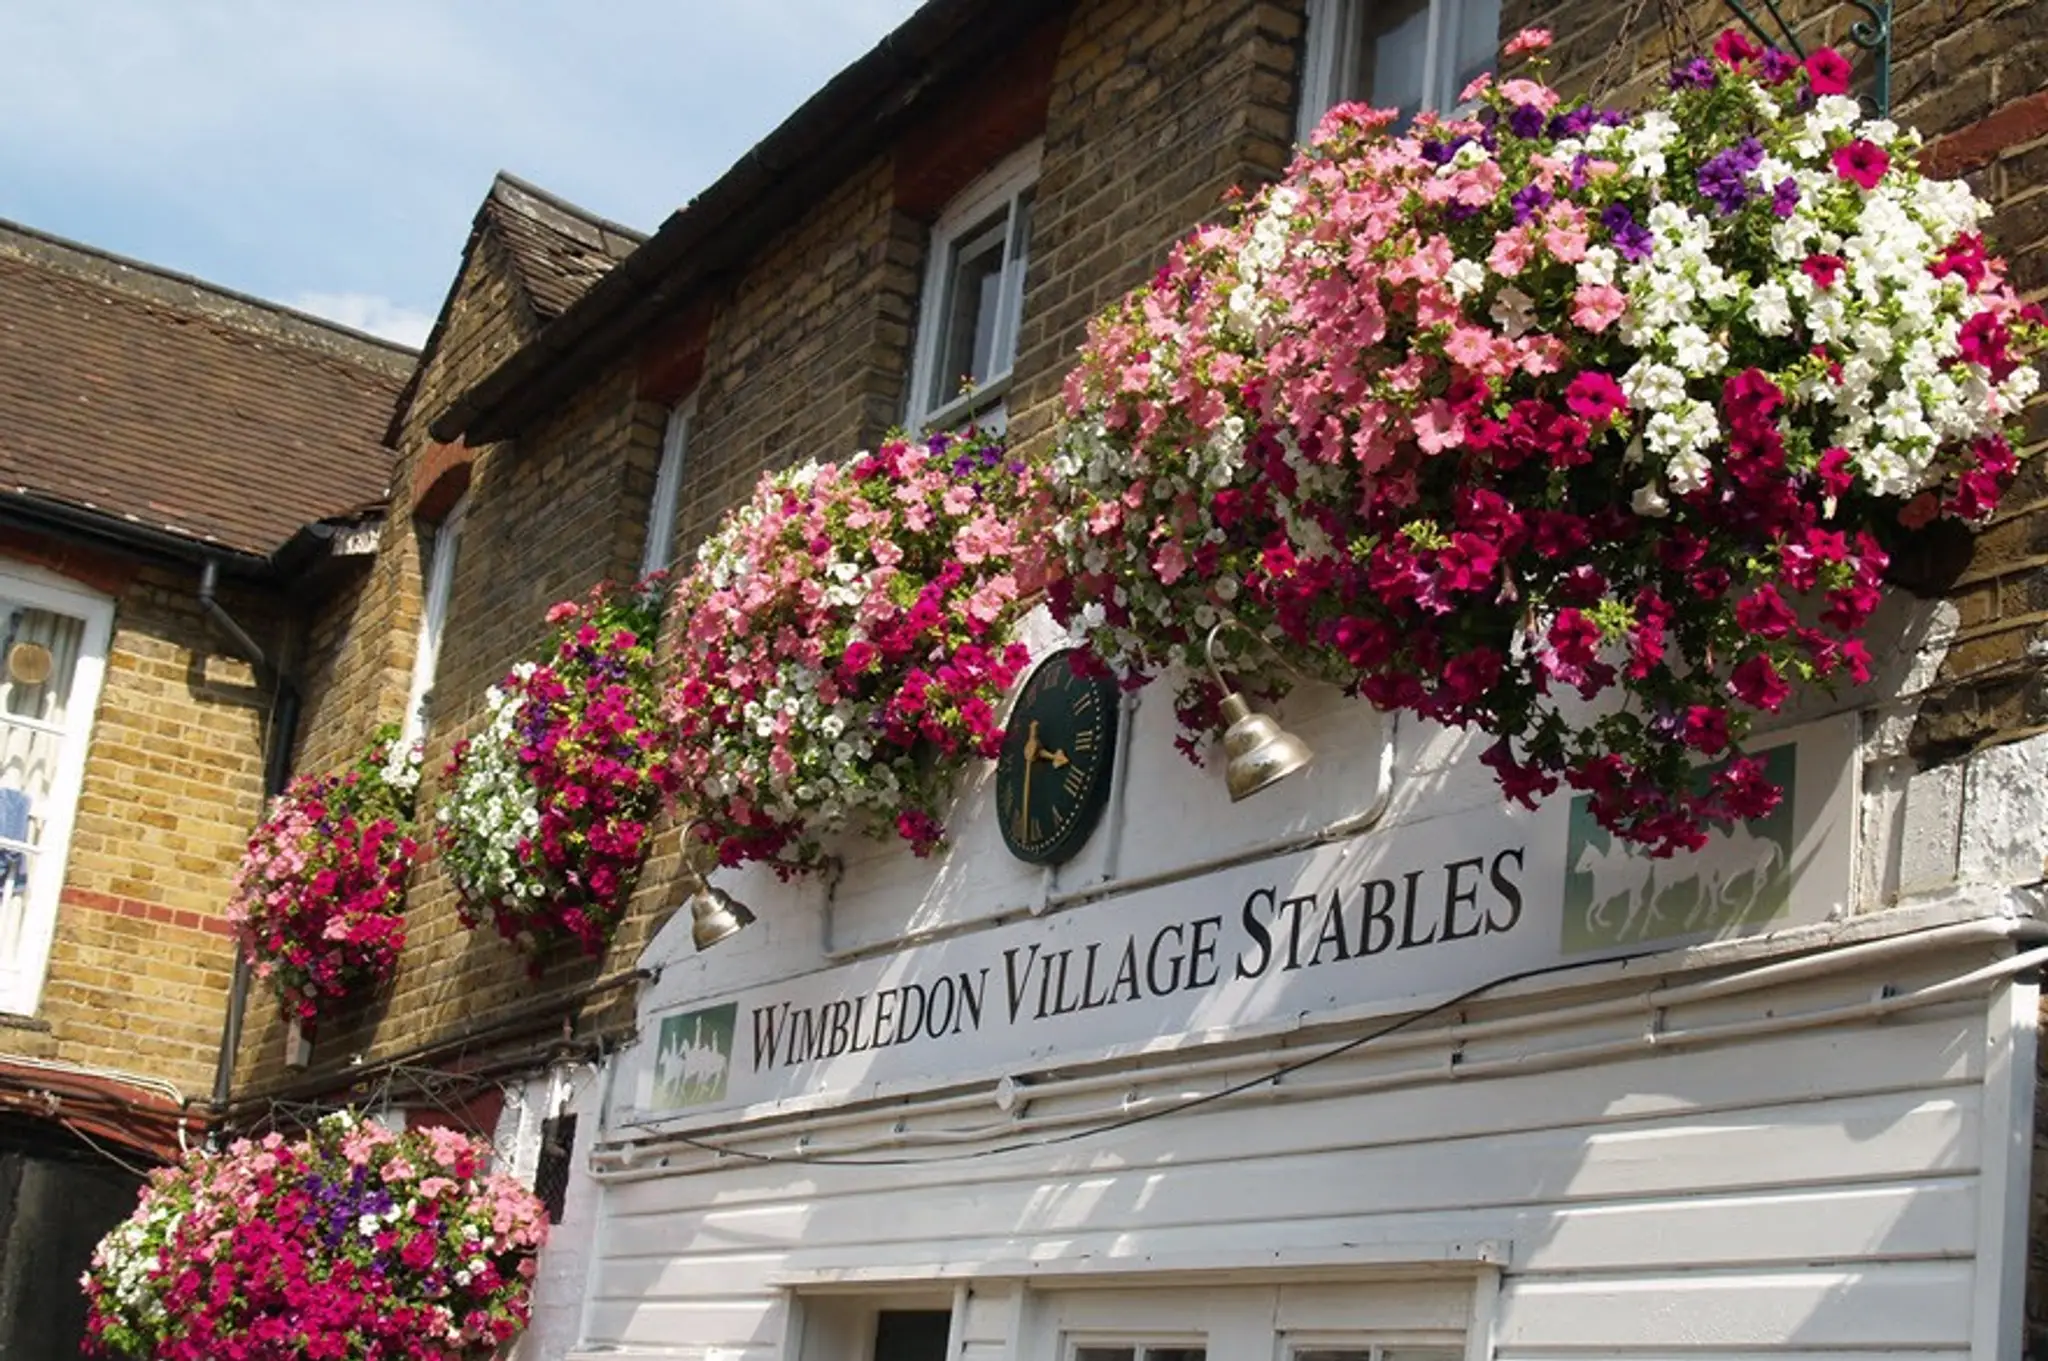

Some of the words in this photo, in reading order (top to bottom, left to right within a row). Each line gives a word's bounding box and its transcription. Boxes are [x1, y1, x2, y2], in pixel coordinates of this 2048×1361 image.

[1075, 729, 1093, 751] III
[753, 968, 989, 1073] WIMBLEDON
[1003, 915, 1222, 1024] VILLAGE
[1235, 846, 1525, 980] STABLES
